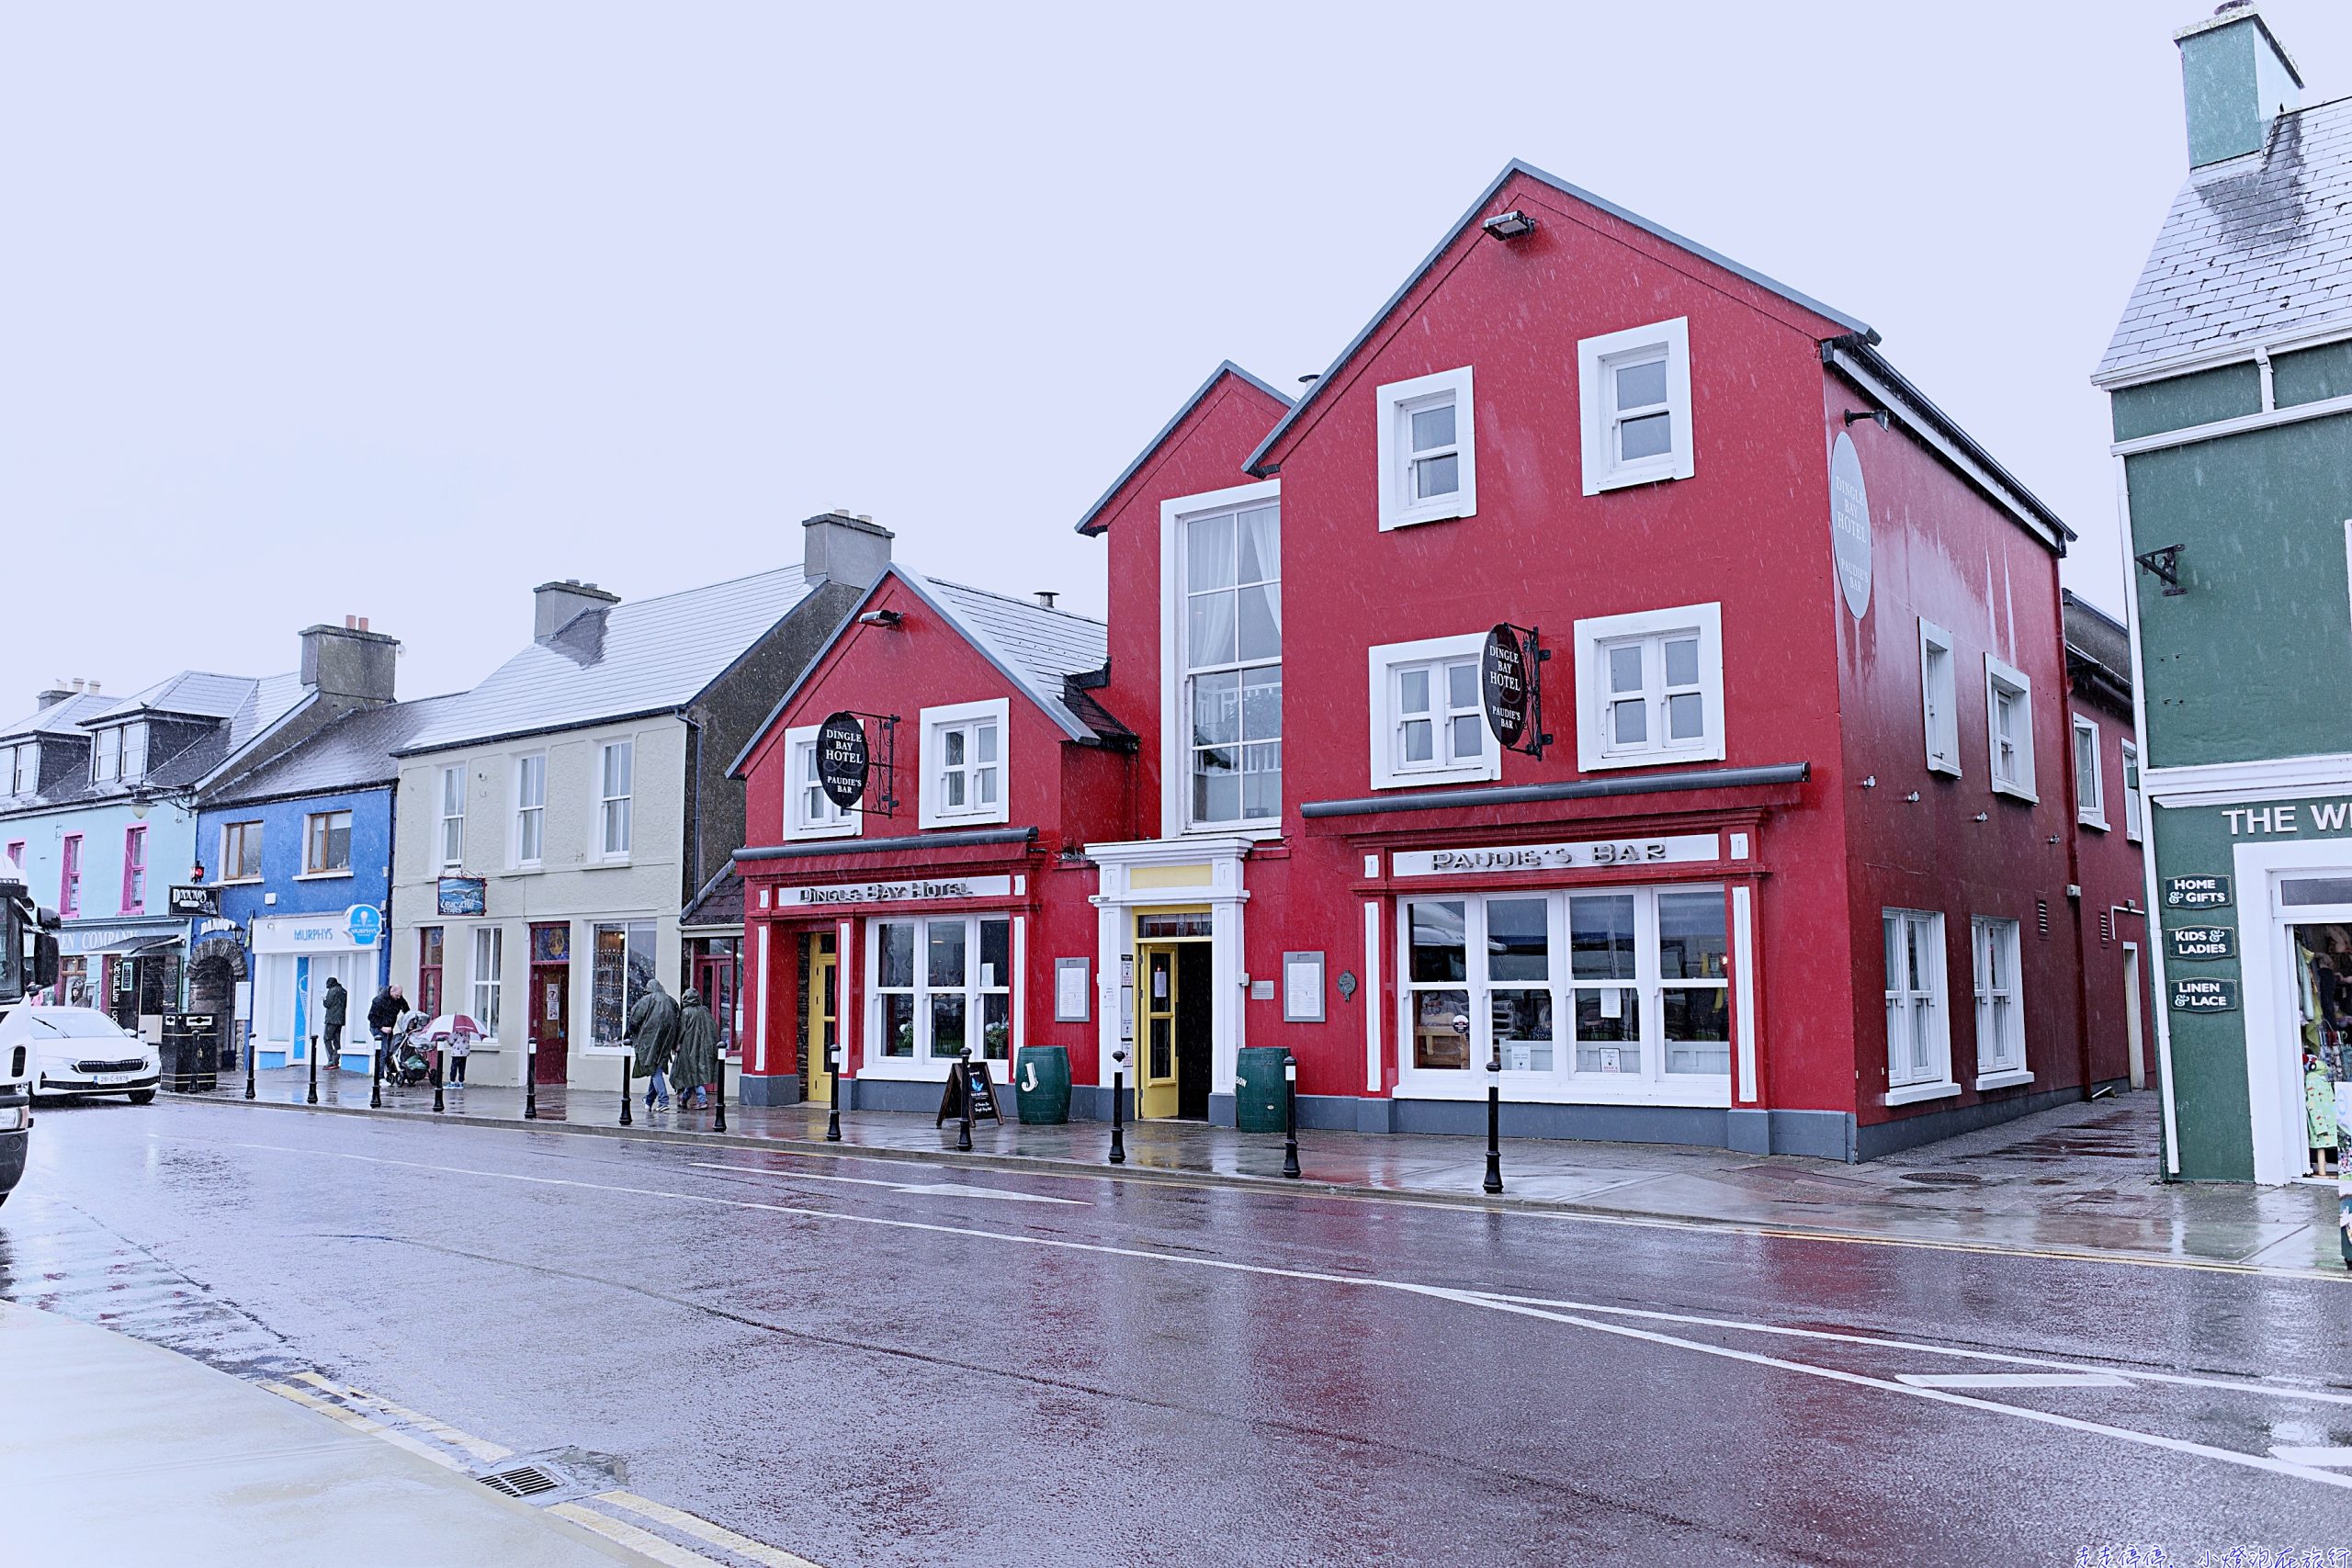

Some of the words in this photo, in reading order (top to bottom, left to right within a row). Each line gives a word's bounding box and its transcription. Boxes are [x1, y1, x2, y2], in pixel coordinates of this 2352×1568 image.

[1836, 475, 1864, 506] DINGLE
[1844, 499, 1858, 519] BAY
[1838, 511, 1867, 544] HOTEL
[1840, 558, 1869, 583] PAUDIE'S
[1849, 576, 1862, 593] BAR
[1489, 645, 1520, 664] DINGLE
[1498, 660, 1512, 674] BAY
[1489, 671, 1521, 692] HOTEL
[1492, 705, 1521, 721] PAUDIE'S
[1500, 717, 1513, 729] BAR
[826, 728, 862, 742] DINGLE
[835, 740, 853, 750] BAY
[825, 749, 863, 764] HOTEL
[827, 775, 862, 787] PAUDIE'S
[837, 784, 853, 794] BAR
[2222, 806, 2298, 835] THE
[2309, 803, 2352, 830] W
[1431, 848, 1573, 870] PAUDIE'S
[1592, 842, 1667, 863] BAR
[2174, 879, 2216, 890] HOME
[799, 887, 864, 903] DINGLE
[866, 884, 908, 900] BAY
[912, 881, 974, 898] HOTEL
[2168, 891, 2184, 904] &
[2186, 892, 2226, 903] GIFTS
[293, 928, 334, 941] MURPHYS
[2175, 931, 2207, 942] KIDS
[2209, 929, 2225, 942] &
[2178, 943, 2226, 954] LADIES
[2178, 982, 2220, 993] LINEN
[2175, 994, 2190, 1007] &
[2191, 996, 2227, 1006] LACE
[1021, 1062, 1039, 1092] J
